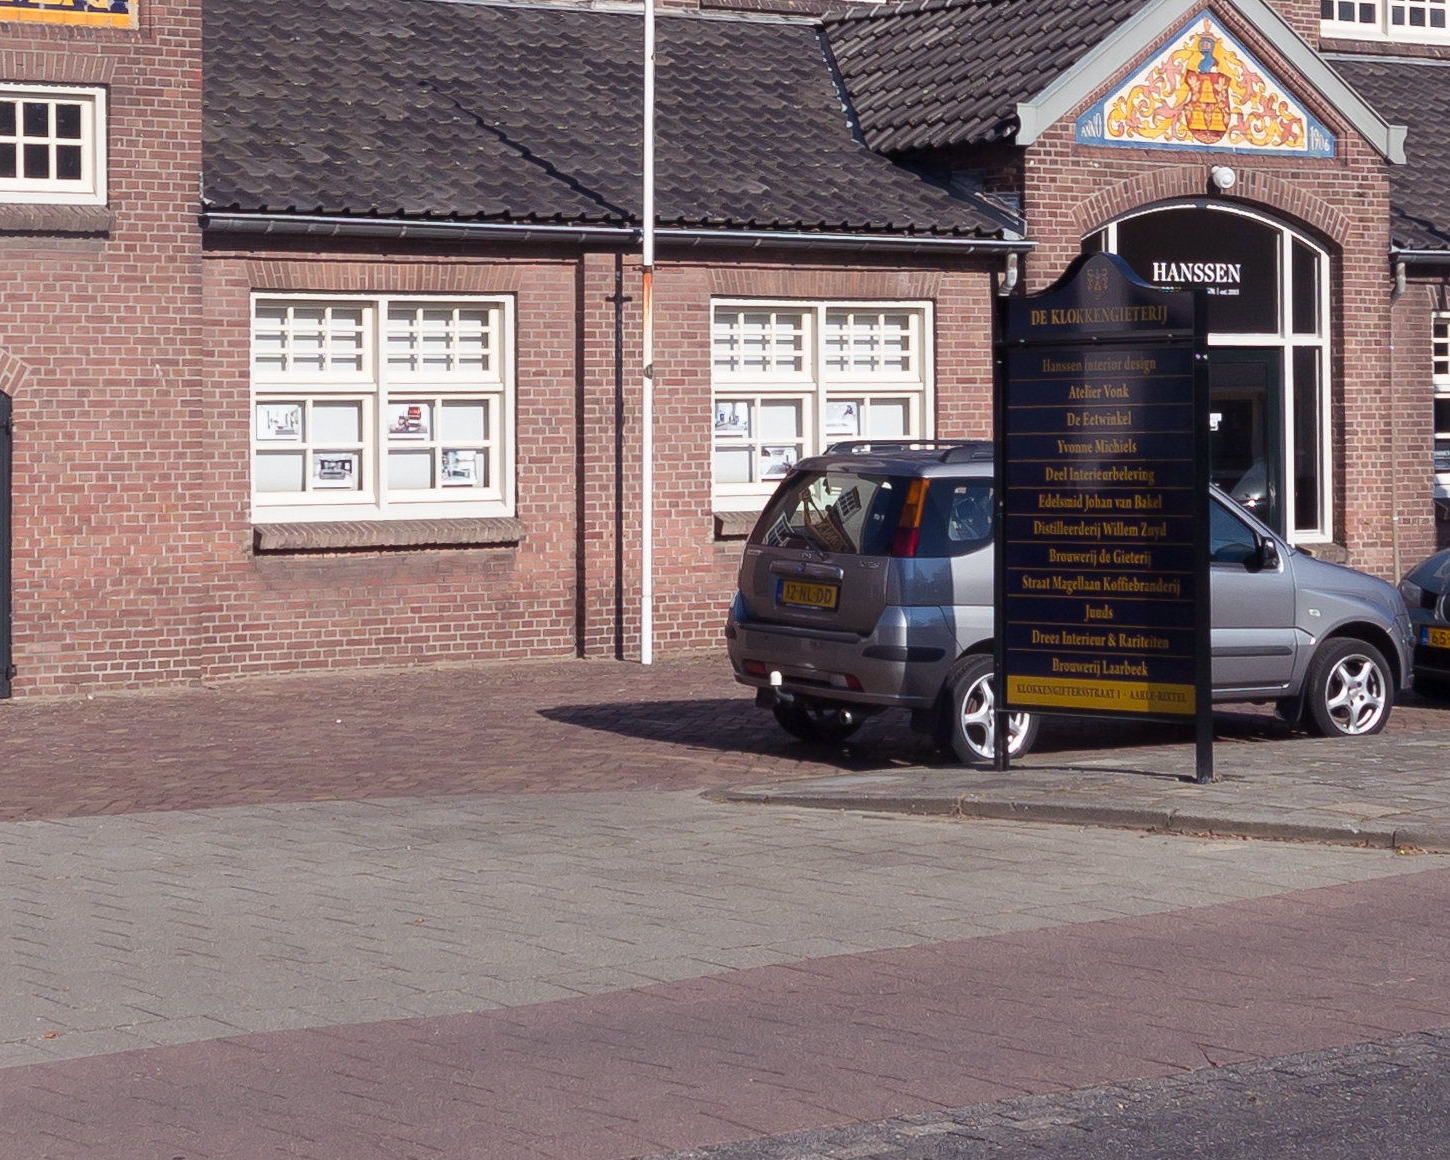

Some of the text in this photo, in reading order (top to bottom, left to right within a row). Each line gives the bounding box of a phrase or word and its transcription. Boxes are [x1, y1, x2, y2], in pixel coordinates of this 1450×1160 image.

[1152, 262, 1241, 283] HANSSEN
[1031, 305, 1168, 326] DE KLOKKENGIETERIJ
[1042, 355, 1156, 374] Hanssen interior design
[1068, 383, 1129, 399] Atelier Vonk
[1067, 412, 1080, 427] De
[1057, 438, 1137, 454] Yvonne Michiels
[1045, 466, 1068, 482] Deel
[1038, 494, 1162, 512] Edelsmid Johan van Bakel
[1033, 520, 1101, 540] Distilleerderij
[1102, 521, 1138, 537] Willem
[1049, 548, 1152, 568] Brouwerij de Gieterij
[1022, 574, 1181, 597] Straat Magellaan Koffiebranderij
[1062, 631, 1106, 647] Interieur
[1107, 633, 1117, 647] &
[1119, 633, 1170, 649] Rariteiten
[1052, 657, 1148, 677] Brouwerij Laarbeek
